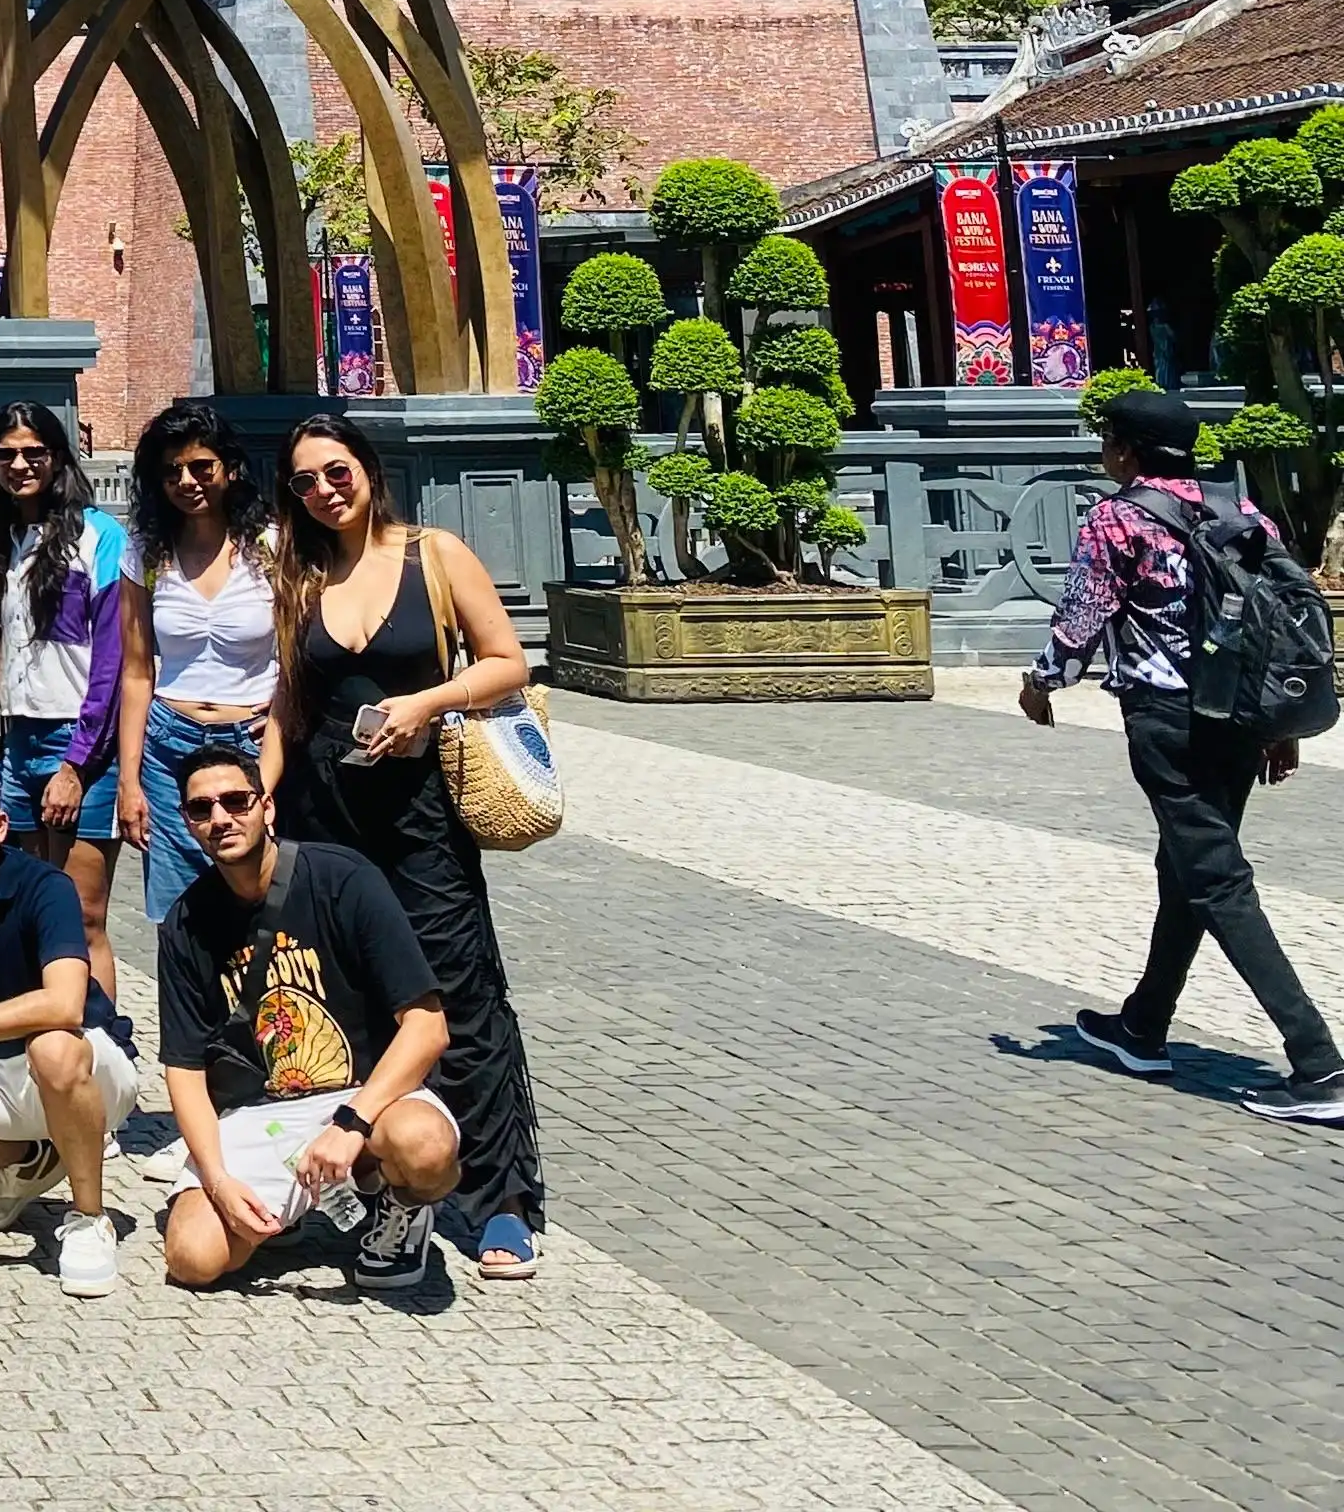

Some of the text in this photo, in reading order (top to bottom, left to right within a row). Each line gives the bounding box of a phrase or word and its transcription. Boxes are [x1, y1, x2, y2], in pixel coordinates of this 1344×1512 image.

[956, 212, 988, 225] BANA
[1032, 210, 1064, 223] BANA
[501, 216, 524, 229] ANA
[963, 225, 985, 236] WOW
[1039, 224, 1061, 234] WOW
[505, 230, 521, 240] OW
[1030, 233, 1072, 244] FESTIVAL
[506, 241, 530, 251] TIVAL
[954, 235, 996, 247] FESTIVAL
[1037, 275, 1074, 284] FRENCH
[343, 285, 363, 293] BANA
